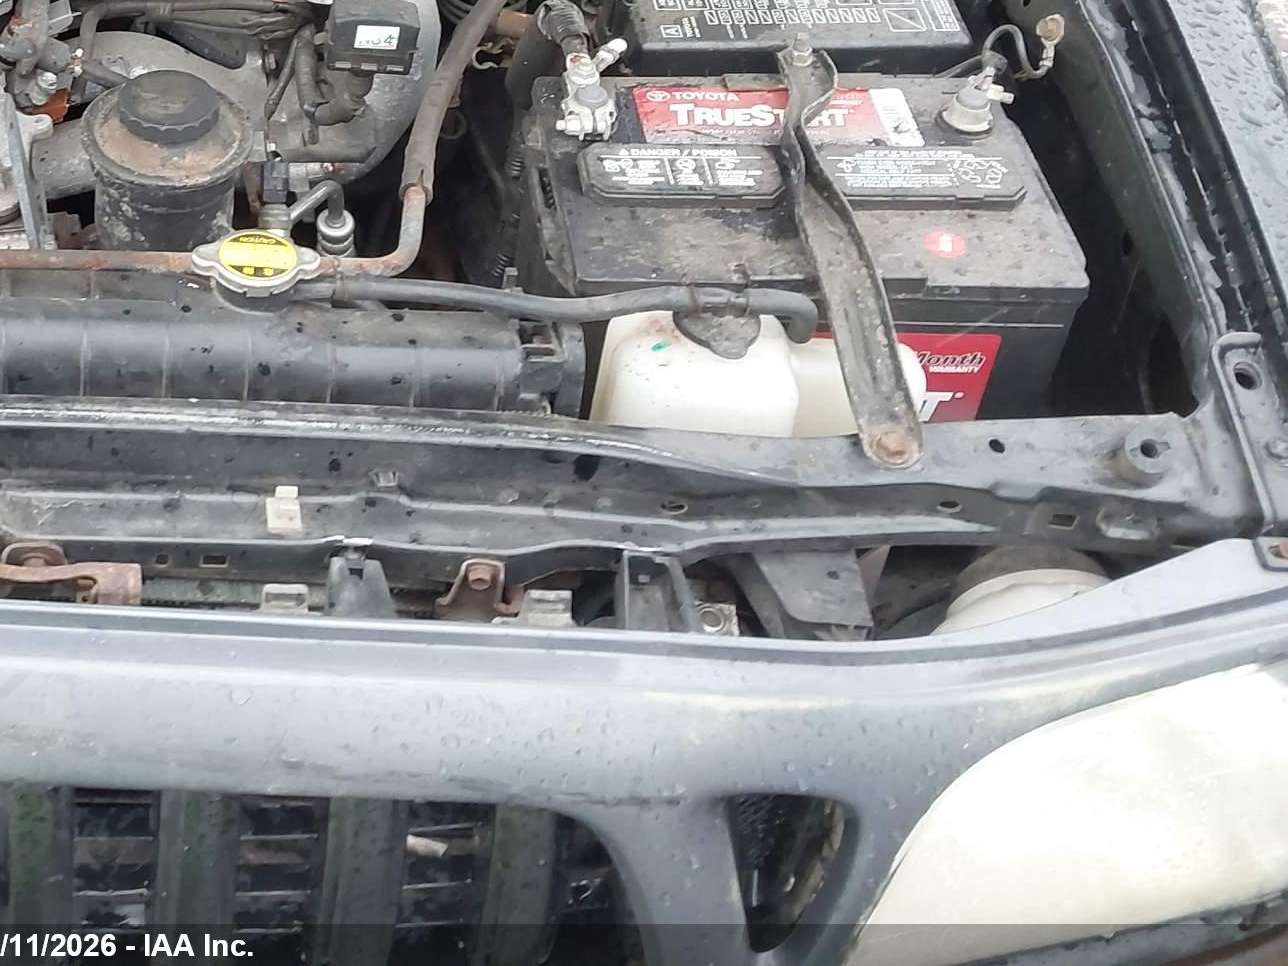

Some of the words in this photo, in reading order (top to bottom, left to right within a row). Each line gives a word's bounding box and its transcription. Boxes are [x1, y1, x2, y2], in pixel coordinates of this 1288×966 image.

[672, 91, 740, 102] TOYOTA
[631, 148, 681, 156] DANGER
[691, 148, 737, 157] POISON
